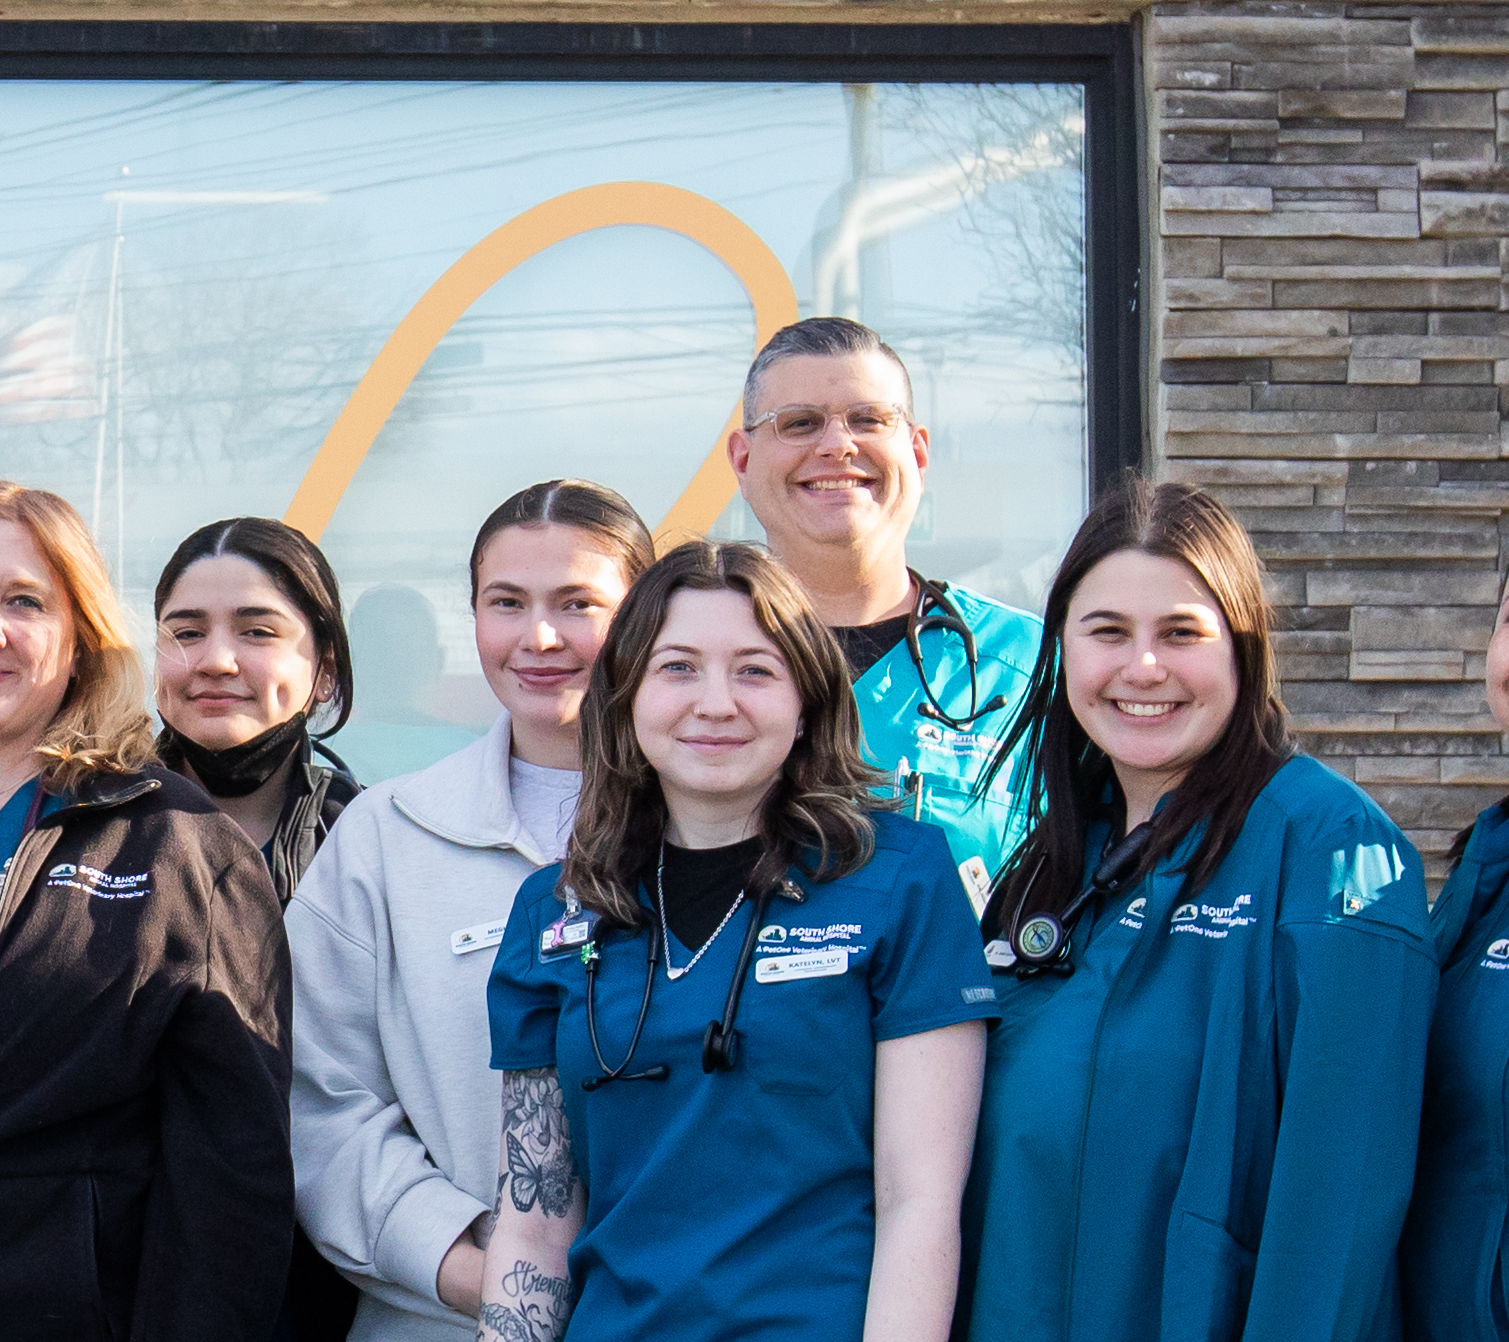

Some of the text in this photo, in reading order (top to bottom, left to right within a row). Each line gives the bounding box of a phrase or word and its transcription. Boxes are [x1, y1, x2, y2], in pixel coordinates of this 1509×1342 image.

[79, 864, 149, 884] SOUTH SHORE
[789, 923, 862, 937] SOUTH SHORE
